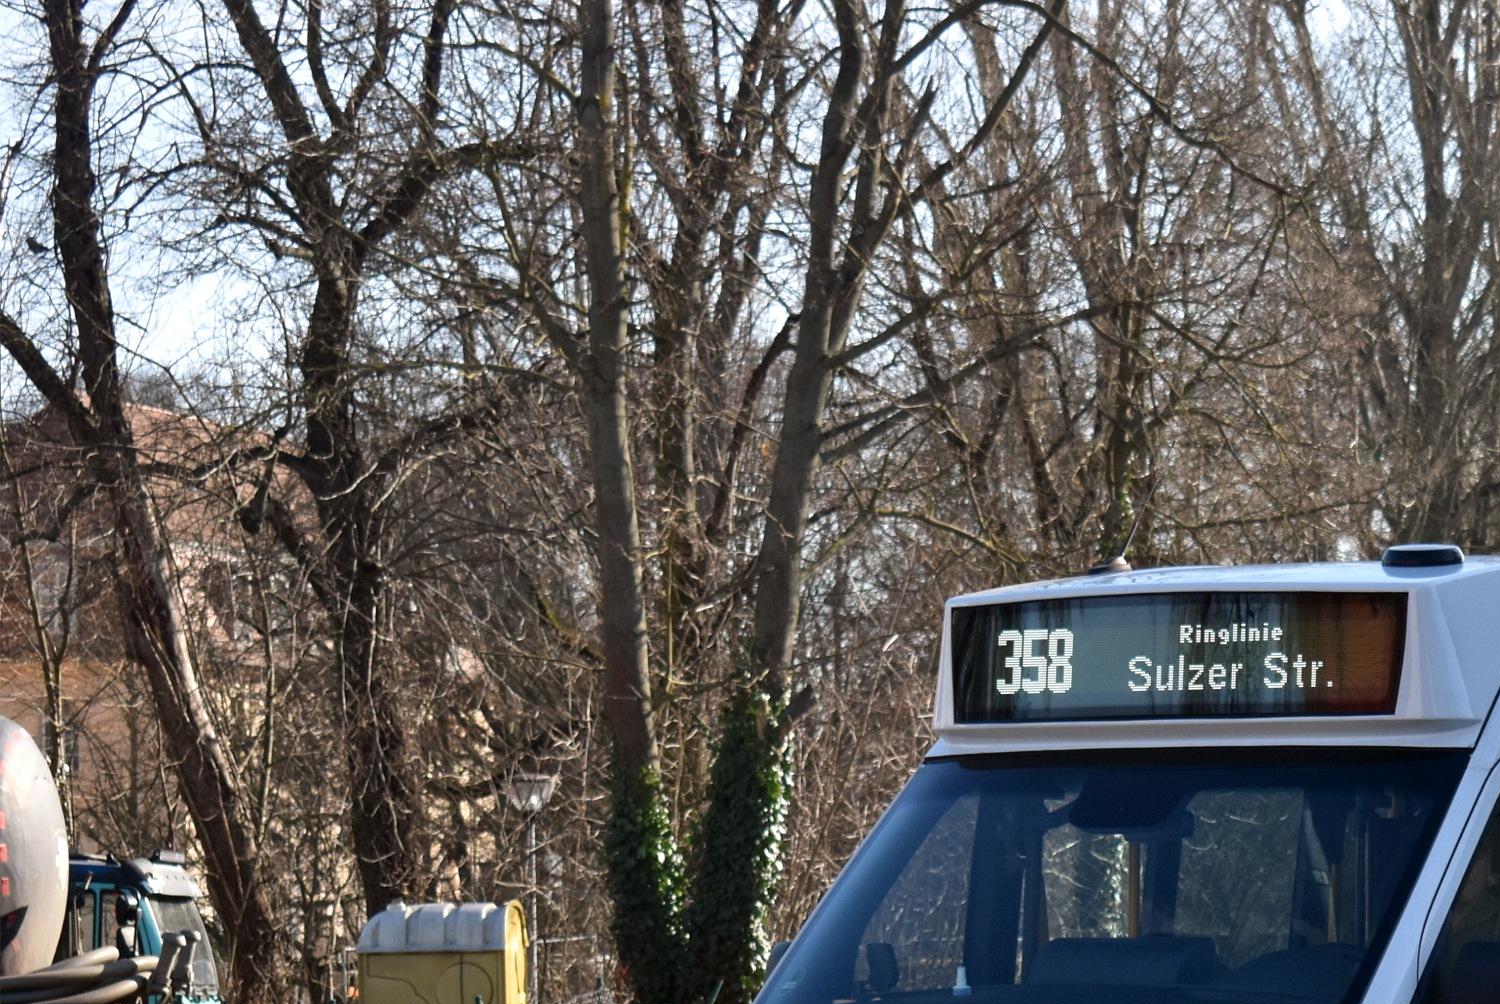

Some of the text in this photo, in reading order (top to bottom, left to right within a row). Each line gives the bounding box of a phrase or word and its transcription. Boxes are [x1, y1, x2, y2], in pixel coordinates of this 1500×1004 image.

[1179, 622, 1284, 645] Ringlinie
[997, 628, 1074, 695] 358
[1127, 652, 1334, 692] Sulzer Str.
